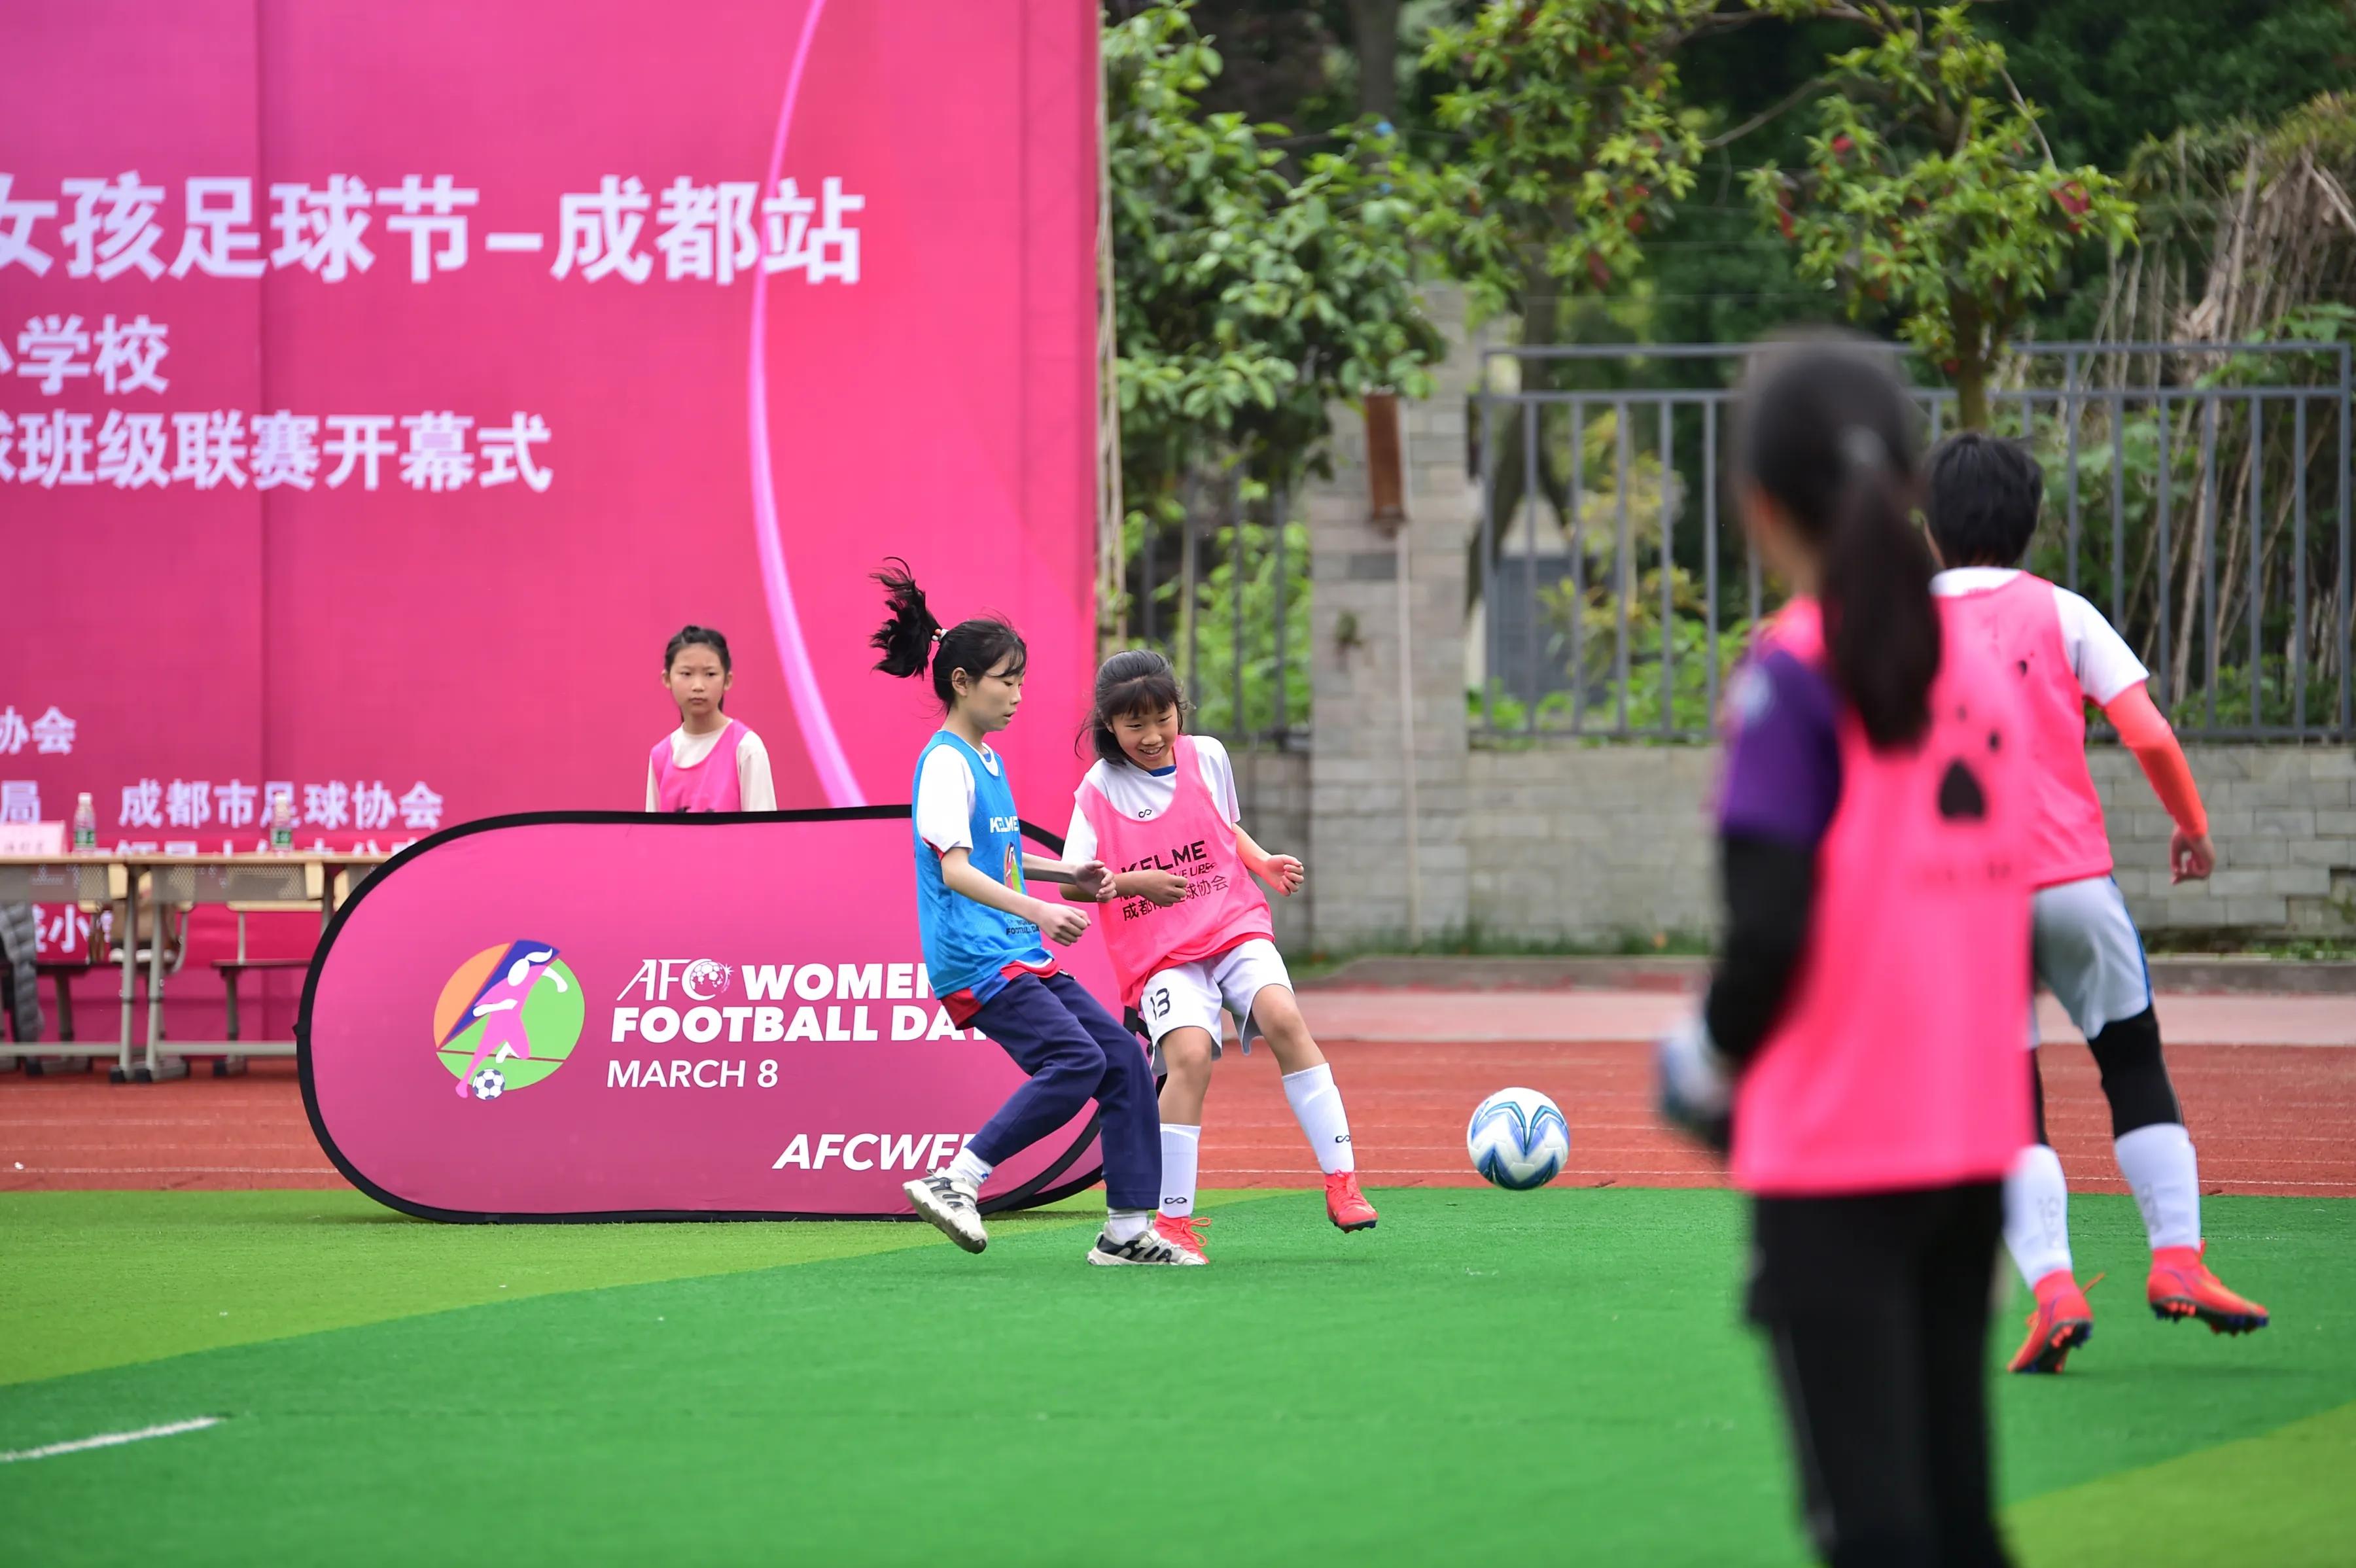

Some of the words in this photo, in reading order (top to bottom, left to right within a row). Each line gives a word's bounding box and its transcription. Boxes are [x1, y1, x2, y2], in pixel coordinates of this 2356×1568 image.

[0, 314, 169, 395] 学校
[0, 409, 554, 493] 班级联赛开幕式
[118, 778, 444, 830] 成都市足球协会
[1122, 875, 1229, 922] 成都球协会
[616, 958, 717, 1002] AFC
[610, 1005, 879, 1042] FOOTBALL
[890, 1004, 987, 1041] DA
[1150, 987, 1170, 1021] 13
[606, 1060, 746, 1088] MARCH
[757, 1059, 779, 1089] 8
